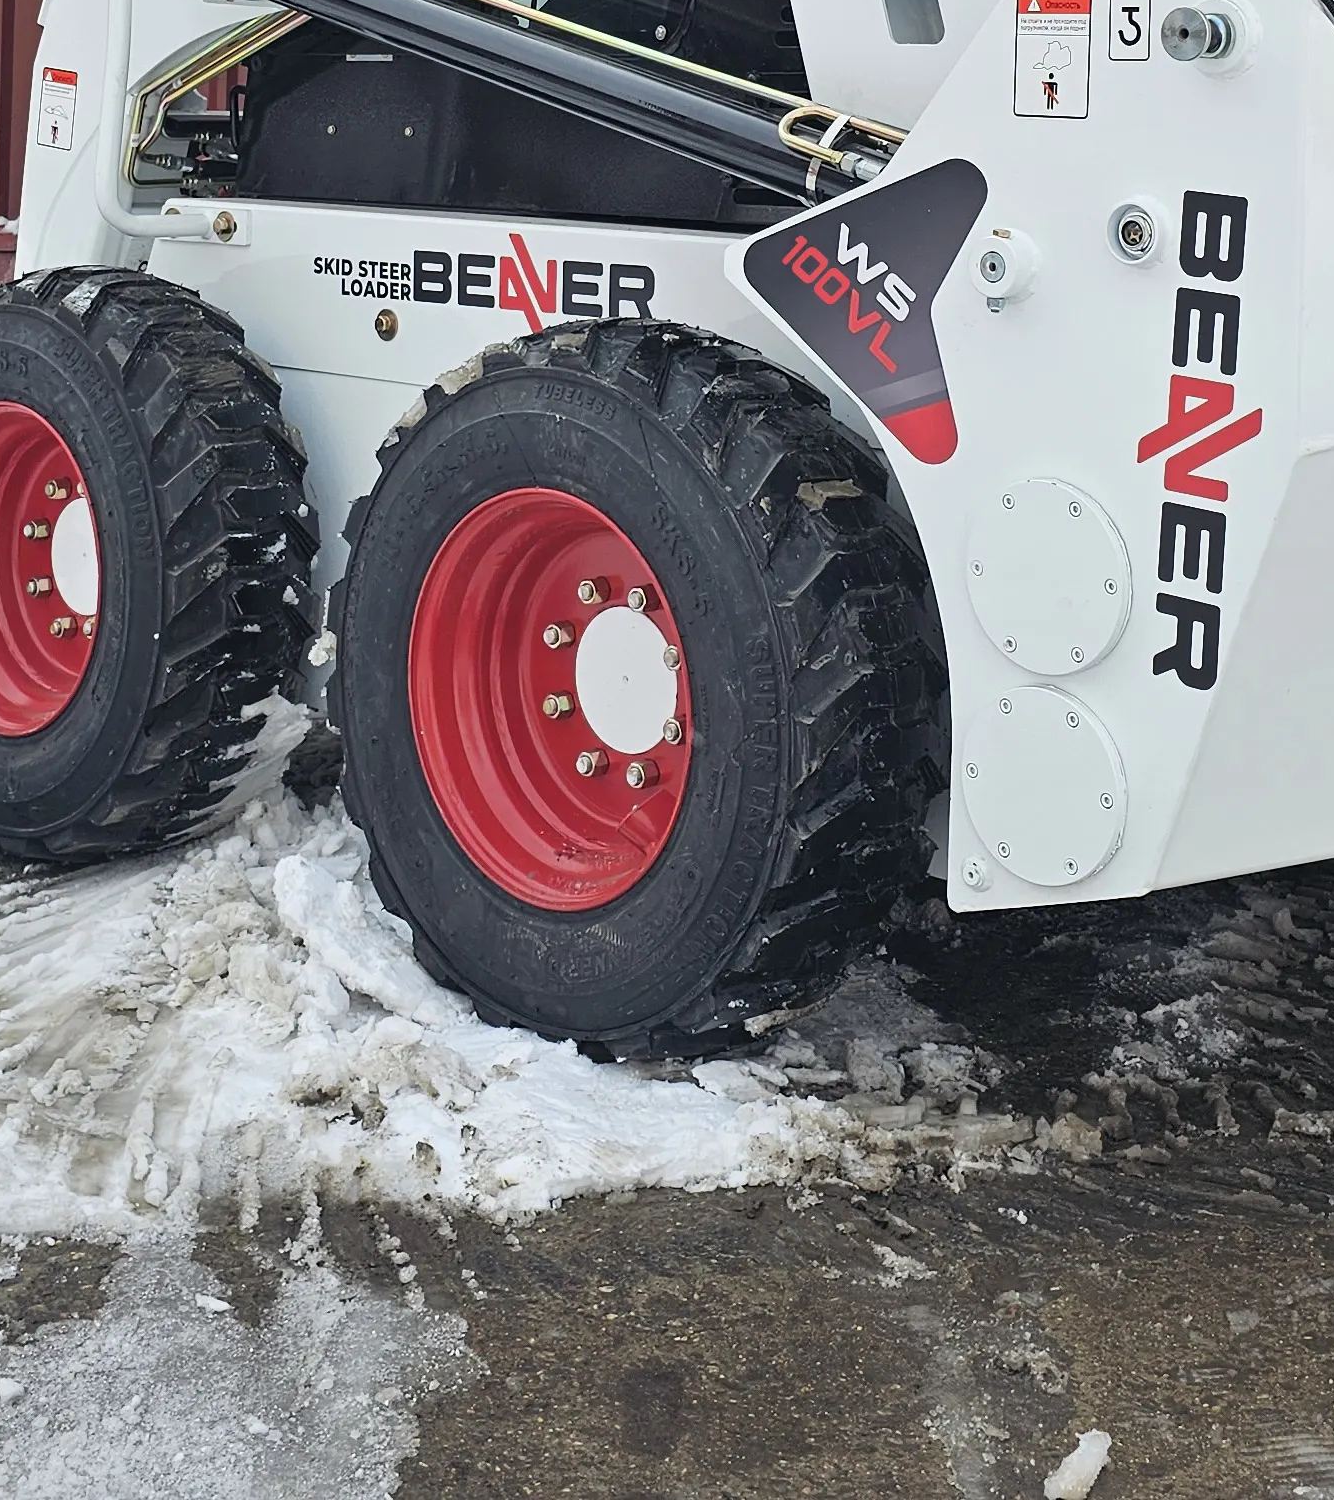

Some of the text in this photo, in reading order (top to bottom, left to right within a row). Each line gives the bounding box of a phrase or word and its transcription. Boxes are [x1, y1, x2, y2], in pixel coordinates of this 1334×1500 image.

[313, 256, 412, 282] SKID STEER
[341, 278, 412, 302] LOADER
[413, 233, 656, 334] BEAVER
[781, 235, 898, 374] 100VL
[837, 222, 917, 322] WS
[533, 381, 617, 421] TUBELESS
[1137, 189, 1263, 691] BEAVER
